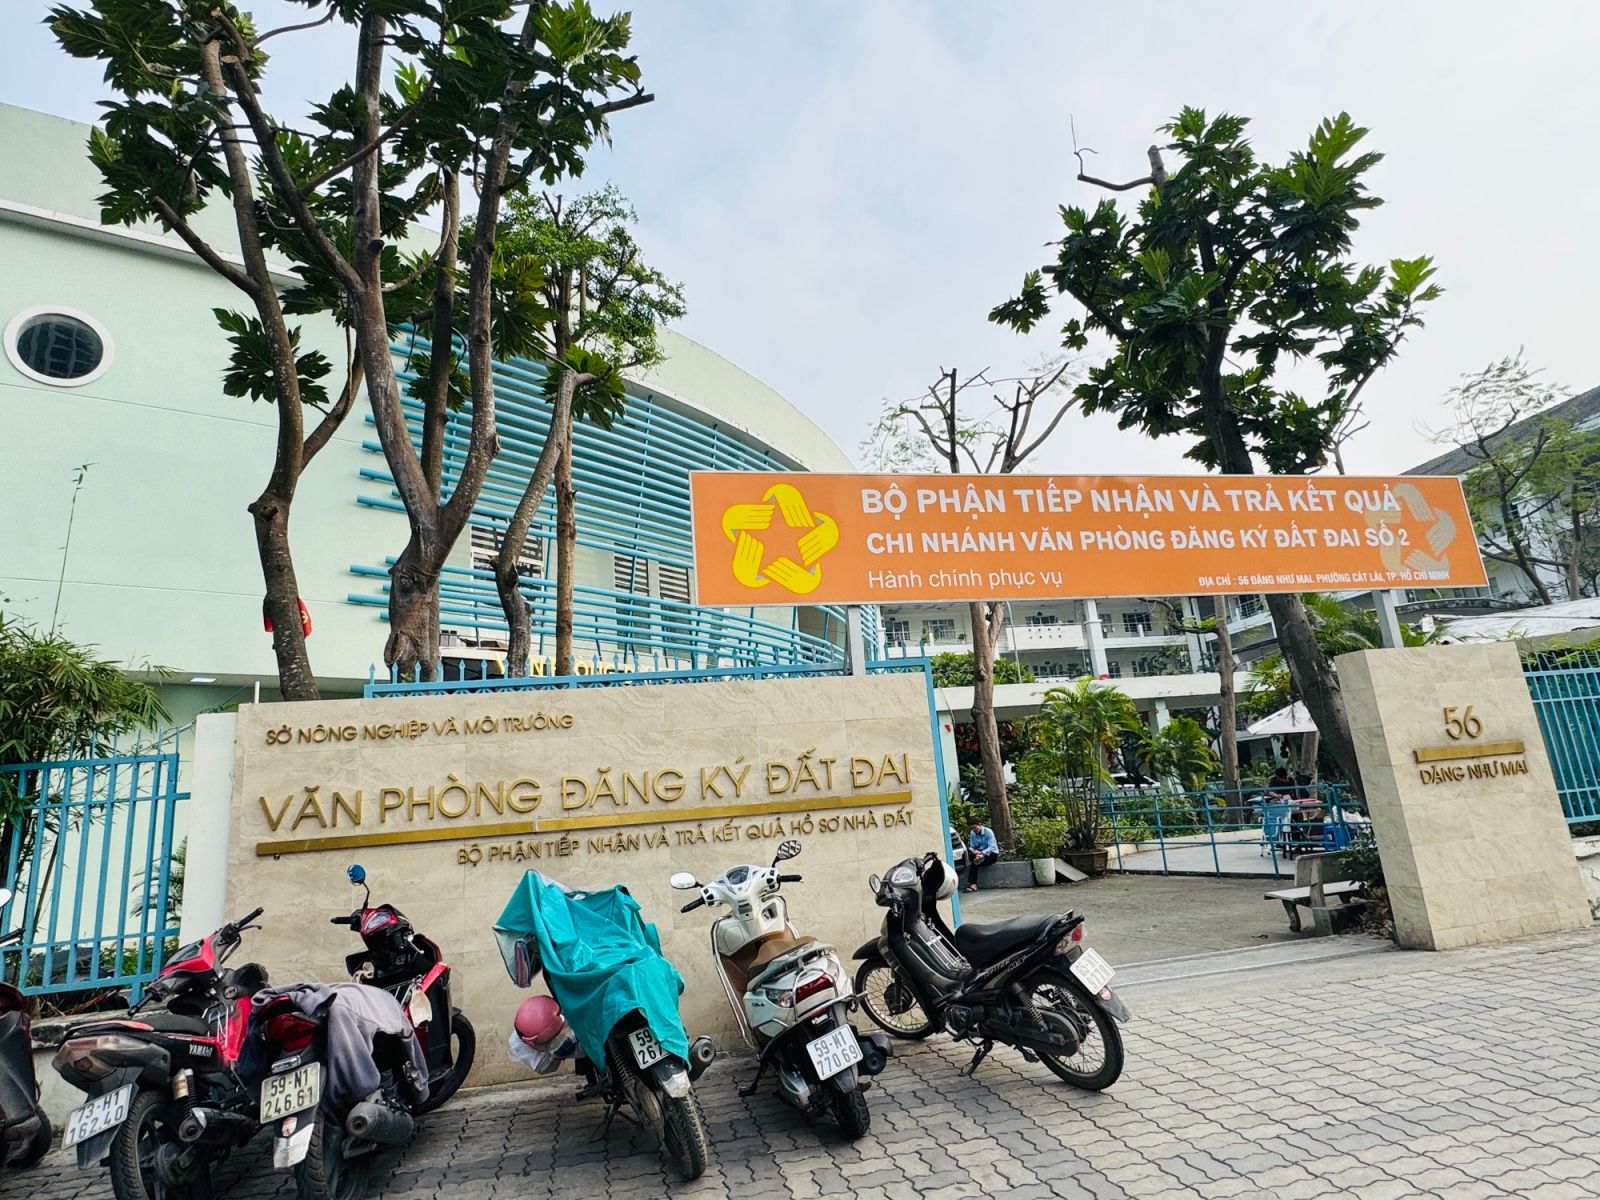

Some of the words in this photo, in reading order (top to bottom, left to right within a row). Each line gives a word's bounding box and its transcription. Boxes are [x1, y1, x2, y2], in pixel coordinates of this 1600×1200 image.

[861, 482, 908, 520] BỘ
[916, 482, 1007, 520] PHẬN
[1013, 477, 1083, 513] TIẾP
[1090, 483, 1175, 519] NHẬN
[1179, 483, 1222, 512] VÀ
[1224, 483, 1284, 512] TRẢ
[1287, 478, 1337, 512] KẾT
[1344, 483, 1401, 514] QUẢ
[866, 532, 914, 554] CHI
[921, 526, 1016, 553] NHÁNH
[1020, 526, 1074, 551] VĂN
[1079, 525, 1166, 550] PHÒNG
[1170, 525, 1236, 549] ĐĂNG
[1240, 523, 1268, 548] KÝ
[1274, 520, 1318, 548] ĐẤT
[1323, 529, 1362, 548] ĐAI
[1365, 519, 1395, 547] SỐ
[1398, 528, 1411, 547] 2
[868, 570, 923, 589] Hành
[928, 568, 983, 588] chính
[988, 568, 1036, 590] phục
[1039, 570, 1063, 588] vụ
[1238, 575, 1249, 586] 56
[1428, 570, 1450, 581] MINH
[266, 724, 293, 745] SỞ
[297, 724, 358, 744] NÔNG
[363, 720, 429, 740] NGHIỆP
[433, 716, 460, 736] VÀ
[463, 715, 499, 735] MÔI
[503, 711, 575, 732] TRƯỜNG
[1443, 705, 1484, 740] 56
[1467, 760, 1499, 780] NHƯ
[1500, 759, 1529, 776] MAI
[259, 785, 363, 831] VĂN
[379, 772, 543, 824] PHÒNG
[560, 766, 687, 810] ĐĂNG
[700, 754, 752, 800] KÝ
[765, 746, 837, 794] ĐẤT
[850, 752, 912, 788] ĐAI
[457, 844, 484, 866] BỘ
[488, 840, 542, 862] PHẬN
[546, 830, 582, 857] TIẾP
[587, 832, 641, 854] NHẬN
[644, 826, 671, 849] VÀ
[675, 824, 708, 845] TRẢ
[712, 818, 743, 843] KẾT
[746, 817, 786, 840] QUẢ
[790, 814, 815, 836] HỒ
[819, 816, 842, 833] SƠ
[843, 810, 878, 832] NHÀ
[883, 806, 915, 828] ĐẤT
[816, 1044, 859, 1076] 770.69
[270, 1069, 309, 1097] 59-N1
[78, 1091, 121, 1123] 73-H1
[264, 1086, 313, 1120] 246.61
[70, 1105, 124, 1143] 162.40
